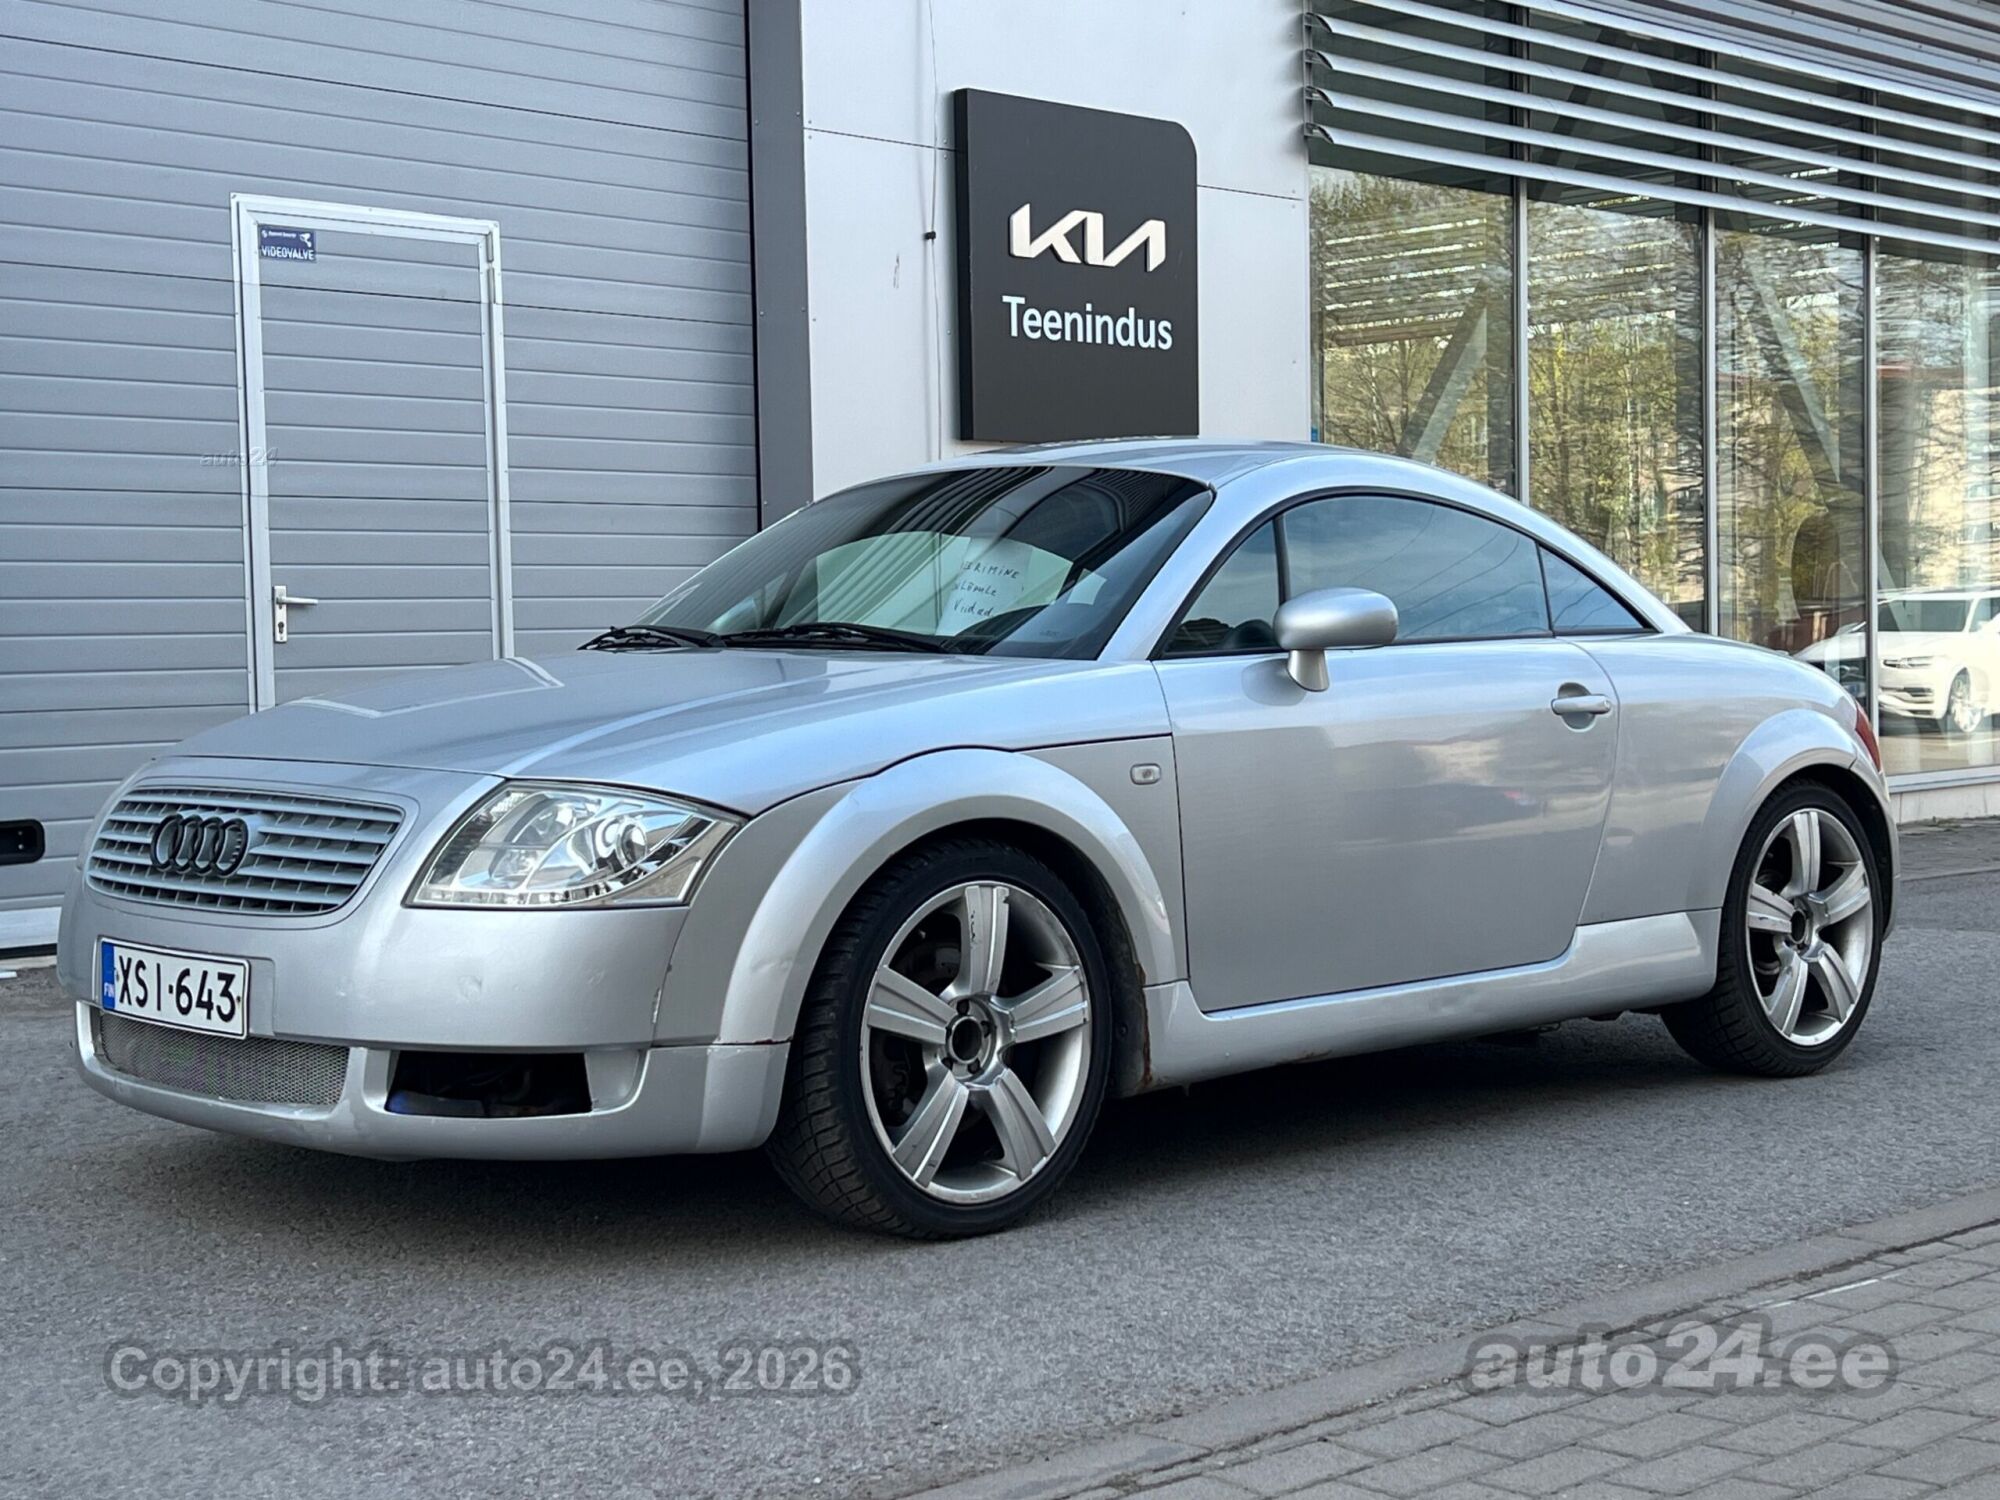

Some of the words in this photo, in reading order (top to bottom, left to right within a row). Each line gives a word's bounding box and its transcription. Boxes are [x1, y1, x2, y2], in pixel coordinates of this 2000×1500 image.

[261, 245, 315, 260] VIDEOVALVE
[1009, 203, 1166, 272] KIA
[1002, 295, 1173, 350] Teenindus
[103, 982, 115, 998] FIN
[119, 955, 237, 1023] XSI-643
